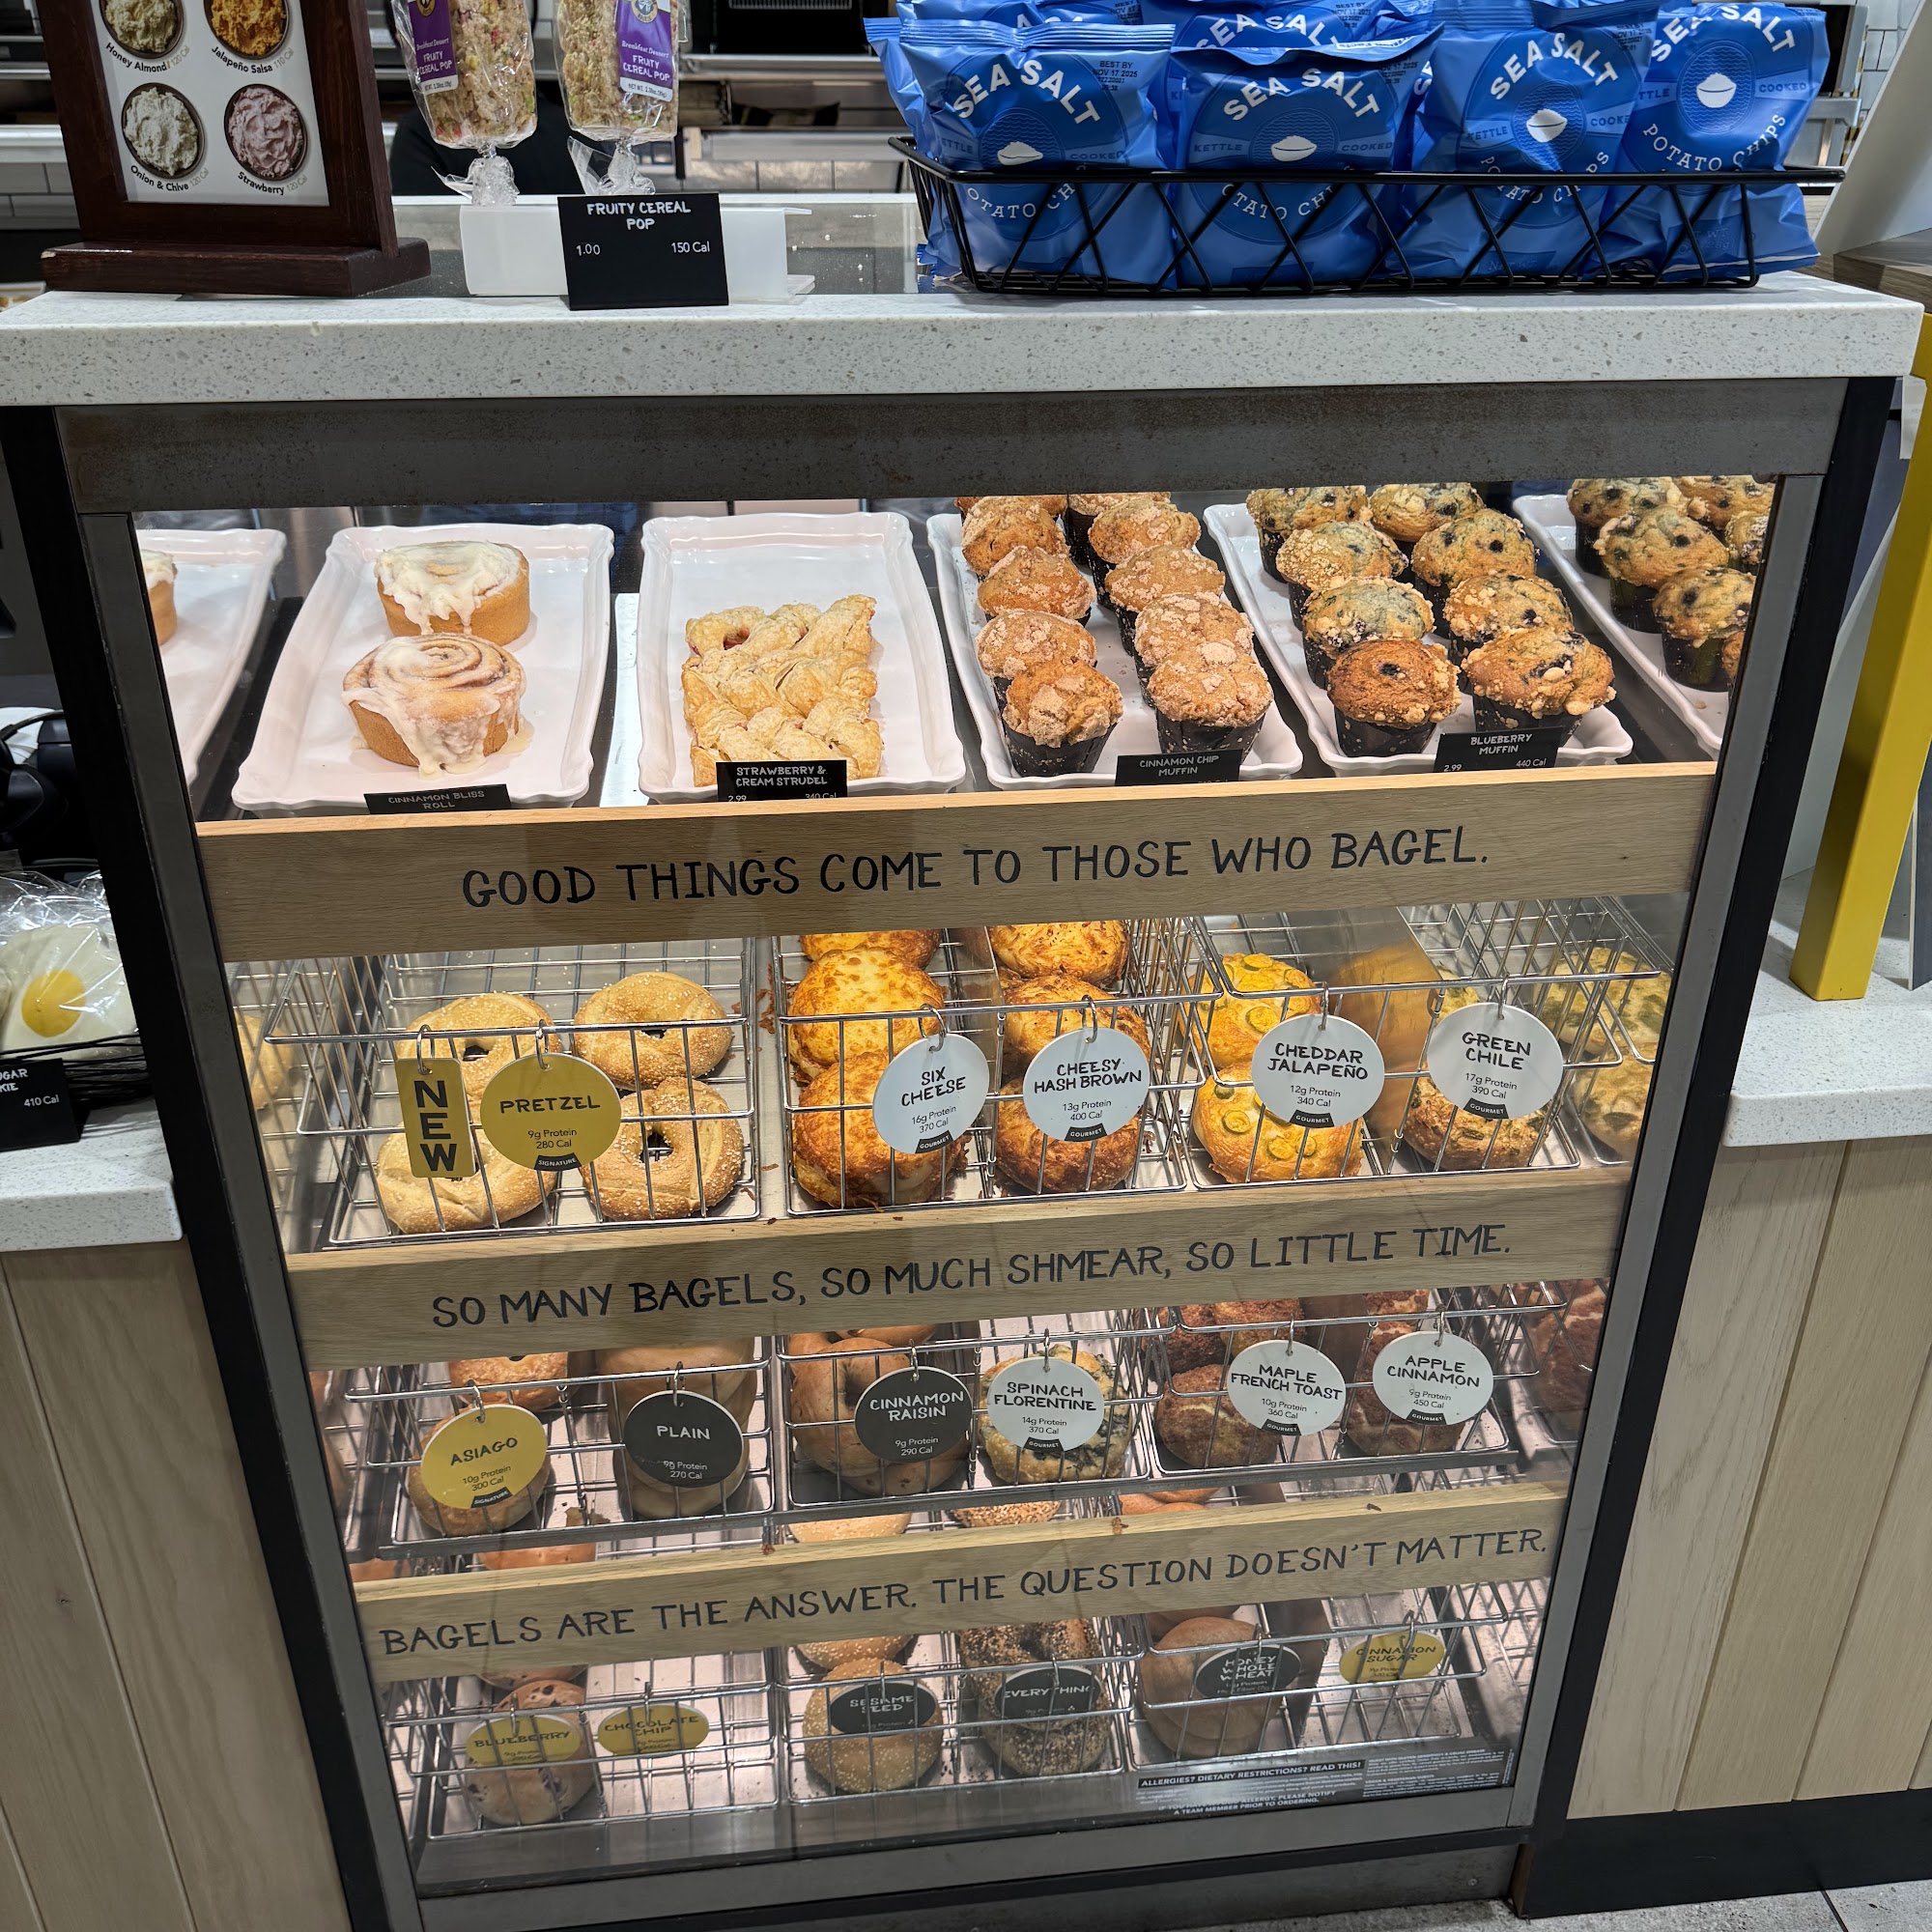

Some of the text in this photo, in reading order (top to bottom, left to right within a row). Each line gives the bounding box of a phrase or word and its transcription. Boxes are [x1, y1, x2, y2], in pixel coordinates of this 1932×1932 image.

[1652, 16, 1713, 62] SEA
[1721, 5, 1795, 52] SALT
[106, 43, 132, 68] Honey
[622, 41, 669, 58] Breakfast Dessert
[212, 46, 272, 73] Jalapeño Salsa
[633, 55, 660, 69] FRUITY
[1491, 40, 1544, 100] SEA
[1551, 33, 1618, 86] SALT
[623, 63, 669, 81] CEREAL POP
[952, 59, 1101, 126] SEA SALT
[1224, 77, 1291, 120] SEA
[1302, 68, 1379, 118] SALT
[1759, 83, 1806, 93] COOKED
[1342, 142, 1393, 152] COOKED
[1643, 114, 1786, 171] POTATO CHIPS
[131, 165, 188, 191] Onion & Chive
[238, 171, 285, 195] Strawberry
[587, 201, 691, 215] FRUITY CEREAL
[967, 187, 1037, 219] OTATO
[627, 218, 655, 230] POP
[577, 242, 710, 256] 1.00 150 Cal
[1470, 734, 1532, 745] BLUEBERRY
[1479, 745, 1519, 754] MUFFIN
[1140, 756, 1193, 768] CINNAMON
[737, 765, 826, 776] STRAWBERRY &
[1159, 767, 1198, 777] MUFFIN
[736, 777, 827, 786] CREAM STRUDEL
[388, 794, 449, 804] CINNAMON
[462, 825, 1489, 908] GOOD THINGS COME TO THOSE WHO BAGEL.
[1462, 1032, 1531, 1056] GREEN
[1274, 1042, 1364, 1064] CHEDDAR
[1465, 1048, 1524, 1070] CHILE
[1057, 1059, 1122, 1076] CHEESY
[1267, 1059, 1369, 1080] JALAPEÑO
[922, 1066, 947, 1086] SIX
[1034, 1070, 1142, 1094] HASH BROWN
[1465, 1072, 1518, 1090] 17g Protein
[900, 1076, 966, 1107] CHEESE
[1291, 1085, 1341, 1097] 12g Protein
[1471, 1085, 1507, 1099] 390 Cal
[24, 1094, 59, 1107] 410 Cal
[499, 1095, 600, 1114] PRETZEL
[1063, 1099, 1112, 1113] 13g Protein
[1296, 1096, 1331, 1107] 340 Cal
[1070, 1112, 1087, 1121] 400
[1469, 1103, 1505, 1115] GOURMET
[413, 1080, 457, 1171] NEW
[1295, 1115, 1330, 1124] GOURMET
[528, 1128, 577, 1140] 9g Protein
[1070, 1128, 1102, 1138] GOURMET
[920, 1135, 950, 1150] GOURMET
[538, 1157, 577, 1167] SIGNATURE
[432, 1224, 1512, 1328] SO MANY BAGELS, SO MUCH SHMEAR, SO LITTLE TIME.
[1405, 1354, 1466, 1374] APPLE
[1259, 1364, 1318, 1383] MAPLE
[1387, 1366, 1480, 1387] CINNAMON
[1007, 1381, 1083, 1397] SPINACH
[1231, 1374, 1343, 1401] FRENCH TOAST
[869, 1391, 964, 1410] CINNAMON
[994, 1394, 1096, 1411] FLORENTINE
[889, 1406, 947, 1422] RAISIN
[1022, 1416, 1067, 1427] 14g Protein
[1411, 1412, 1443, 1422] GOURMET
[657, 1426, 710, 1440] PLAIN
[1266, 1424, 1297, 1433] GOURMET
[895, 1436, 939, 1448] 9g Protein
[450, 1437, 518, 1466] ASIAGO
[900, 1447, 918, 1456] 290
[664, 1460, 708, 1470] 9g Protein
[669, 1470, 702, 1480] 270 Cal
[473, 1491, 510, 1506] SIGNATURE
[379, 1528, 1547, 1655] BAGELS ARE THE ANSWER. THE QUESTION DOESN'T MATTER.
[1222, 1663, 1275, 1673] WHOLE
[1225, 1656, 1276, 1666] HONEY
[1220, 1670, 1274, 1681] WHEAT
[850, 1695, 914, 1707] SESAME
[862, 1704, 903, 1714] SEED
[604, 1717, 699, 1732] CHOCOLATE
[635, 1726, 671, 1736] CHIP
[474, 1731, 570, 1747] BLUEBERRY
[1141, 1776, 1196, 1786] ALLERGIES?
[1198, 1773, 1236, 1782] DIETARY
[1237, 1766, 1308, 1778] RESTRICTIONS?
